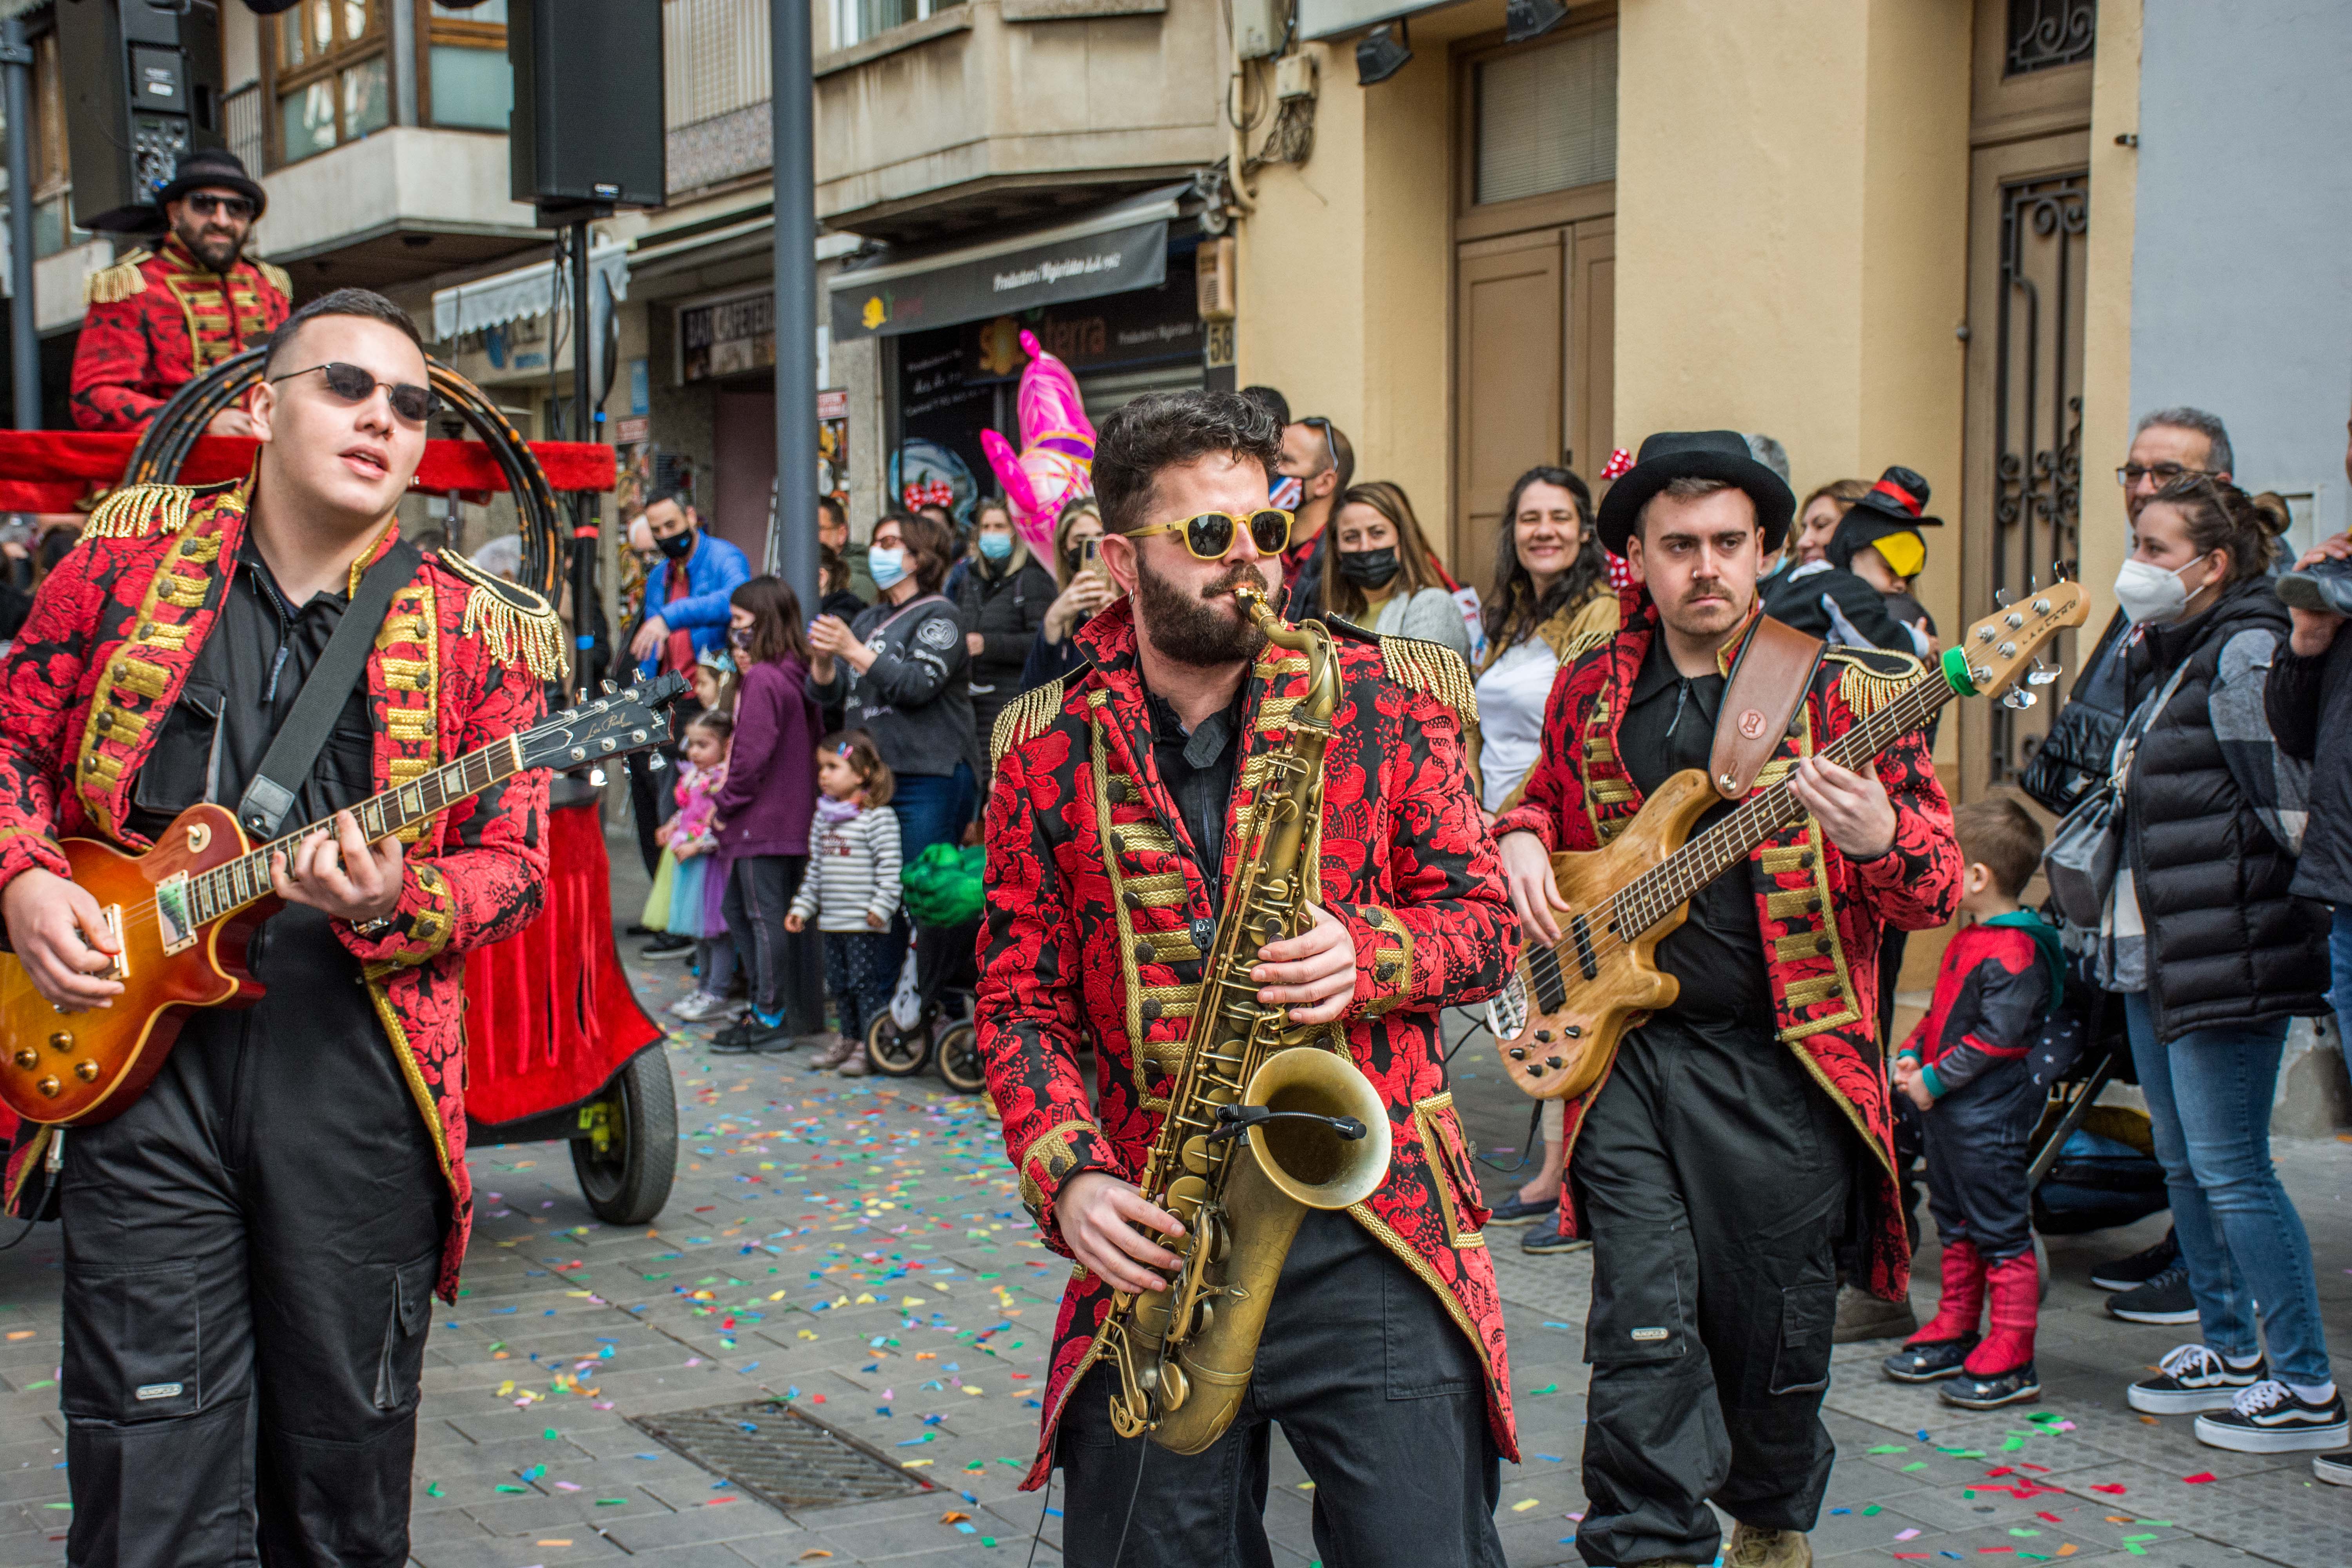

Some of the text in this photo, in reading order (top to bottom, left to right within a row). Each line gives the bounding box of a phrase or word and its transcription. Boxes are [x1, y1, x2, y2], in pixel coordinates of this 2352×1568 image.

[1210, 325, 1233, 361] 58
[2023, 599, 2076, 645] LAKLAND
[581, 711, 626, 743] Les Paul
